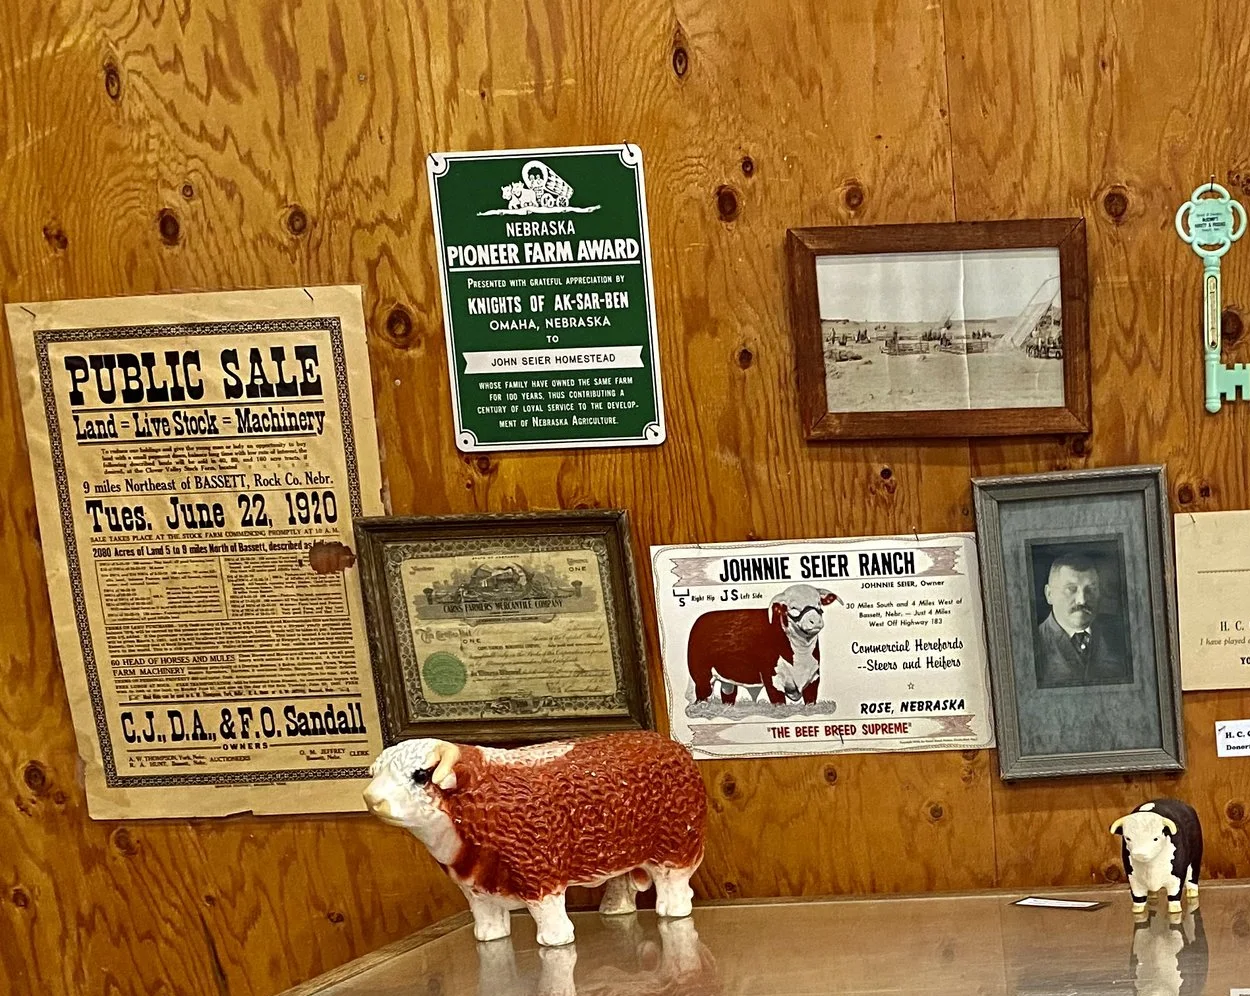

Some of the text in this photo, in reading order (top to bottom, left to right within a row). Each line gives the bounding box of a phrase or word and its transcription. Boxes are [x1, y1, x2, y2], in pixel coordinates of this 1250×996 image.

[506, 220, 575, 237] NEBRASKA
[447, 238, 639, 266] PIONEER FARM AWARD
[467, 291, 628, 314] KNIGHTS OF AK-SAR-BEN
[490, 316, 610, 331] OMAHA, NEBRASKA
[546, 335, 559, 343] TO
[491, 354, 616, 367] JOHN SEIER HOMESTEAD
[64, 345, 322, 406] PUBLIC SALE
[479, 381, 502, 389] WHOSE
[505, 380, 528, 389] FAMILY
[531, 380, 548, 388] HAVE
[552, 379, 575, 388] OWNED
[594, 378, 611, 386] SAME
[615, 377, 633, 385] FARM
[173, 409, 216, 436] Stock
[237, 407, 326, 436] Machinery
[83, 472, 334, 493] 9 miles Northeast of BASSETT, Rock Co. Nebr.
[86, 500, 152, 533] Tues.
[167, 497, 225, 529] June
[238, 494, 272, 528] 22,
[720, 551, 916, 583] JOHNNIE SEIER RANCH
[860, 581, 894, 589] JOHNNIE
[896, 580, 918, 588] SEIER,
[899, 618, 929, 628] Highway
[1220, 621, 1229, 631] H.
[1235, 620, 1244, 630] C.
[851, 638, 963, 654] Commercial Herefords
[902, 659, 921, 670] and
[926, 657, 961, 669] Heifers
[113, 667, 185, 676] FARM MACHINERY
[860, 699, 966, 715] ROSE, NEBRASKA
[219, 708, 235, 739] &
[284, 702, 366, 736] Sandall
[795, 725, 819, 737] BEEF
[824, 724, 857, 737] BREED
[862, 722, 912, 735] SUPREME"
[1225, 731, 1234, 739] H.
[222, 742, 268, 750] OWNERS
